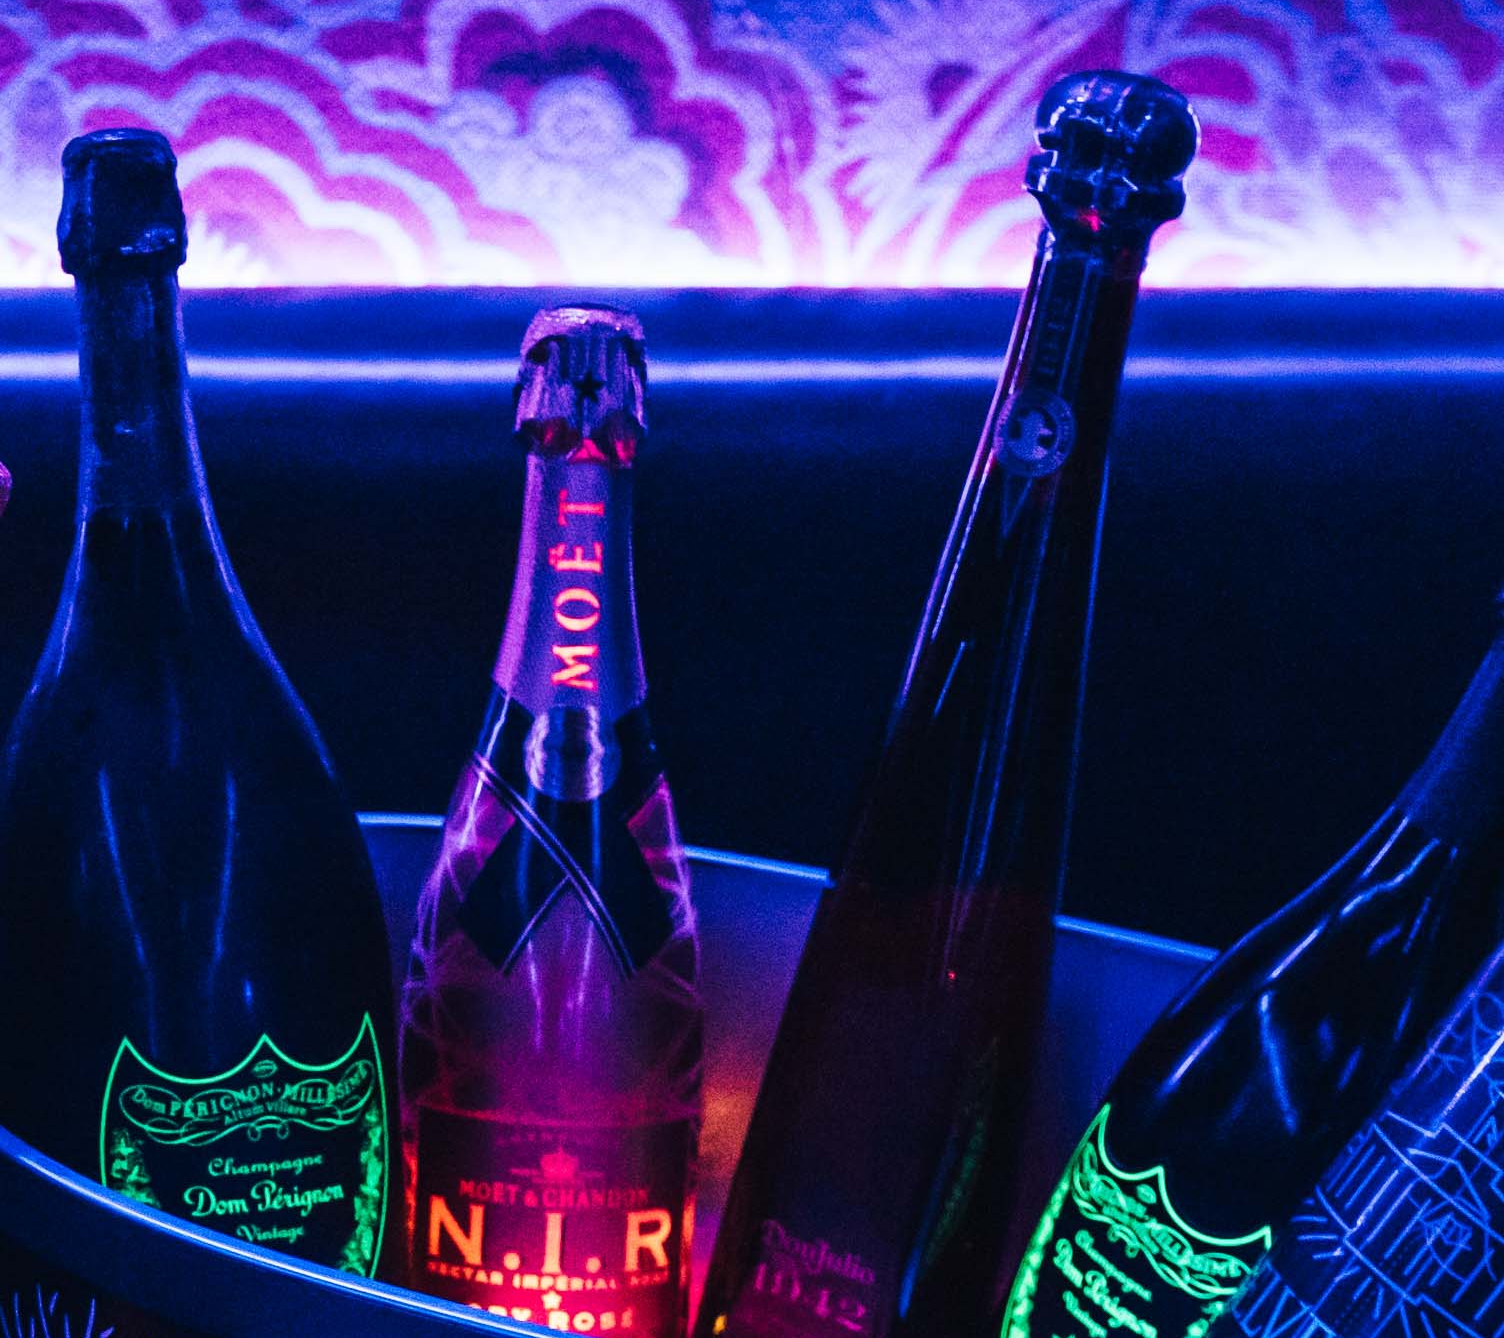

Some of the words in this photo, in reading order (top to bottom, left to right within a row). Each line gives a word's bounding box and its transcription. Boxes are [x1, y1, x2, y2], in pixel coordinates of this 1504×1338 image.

[548, 489, 605, 693] MOËT
[208, 1153, 324, 1177] Champagne
[183, 1185, 249, 1217] Dom
[250, 1179, 345, 1217] Pérignon
[236, 1223, 305, 1243] Vintage
